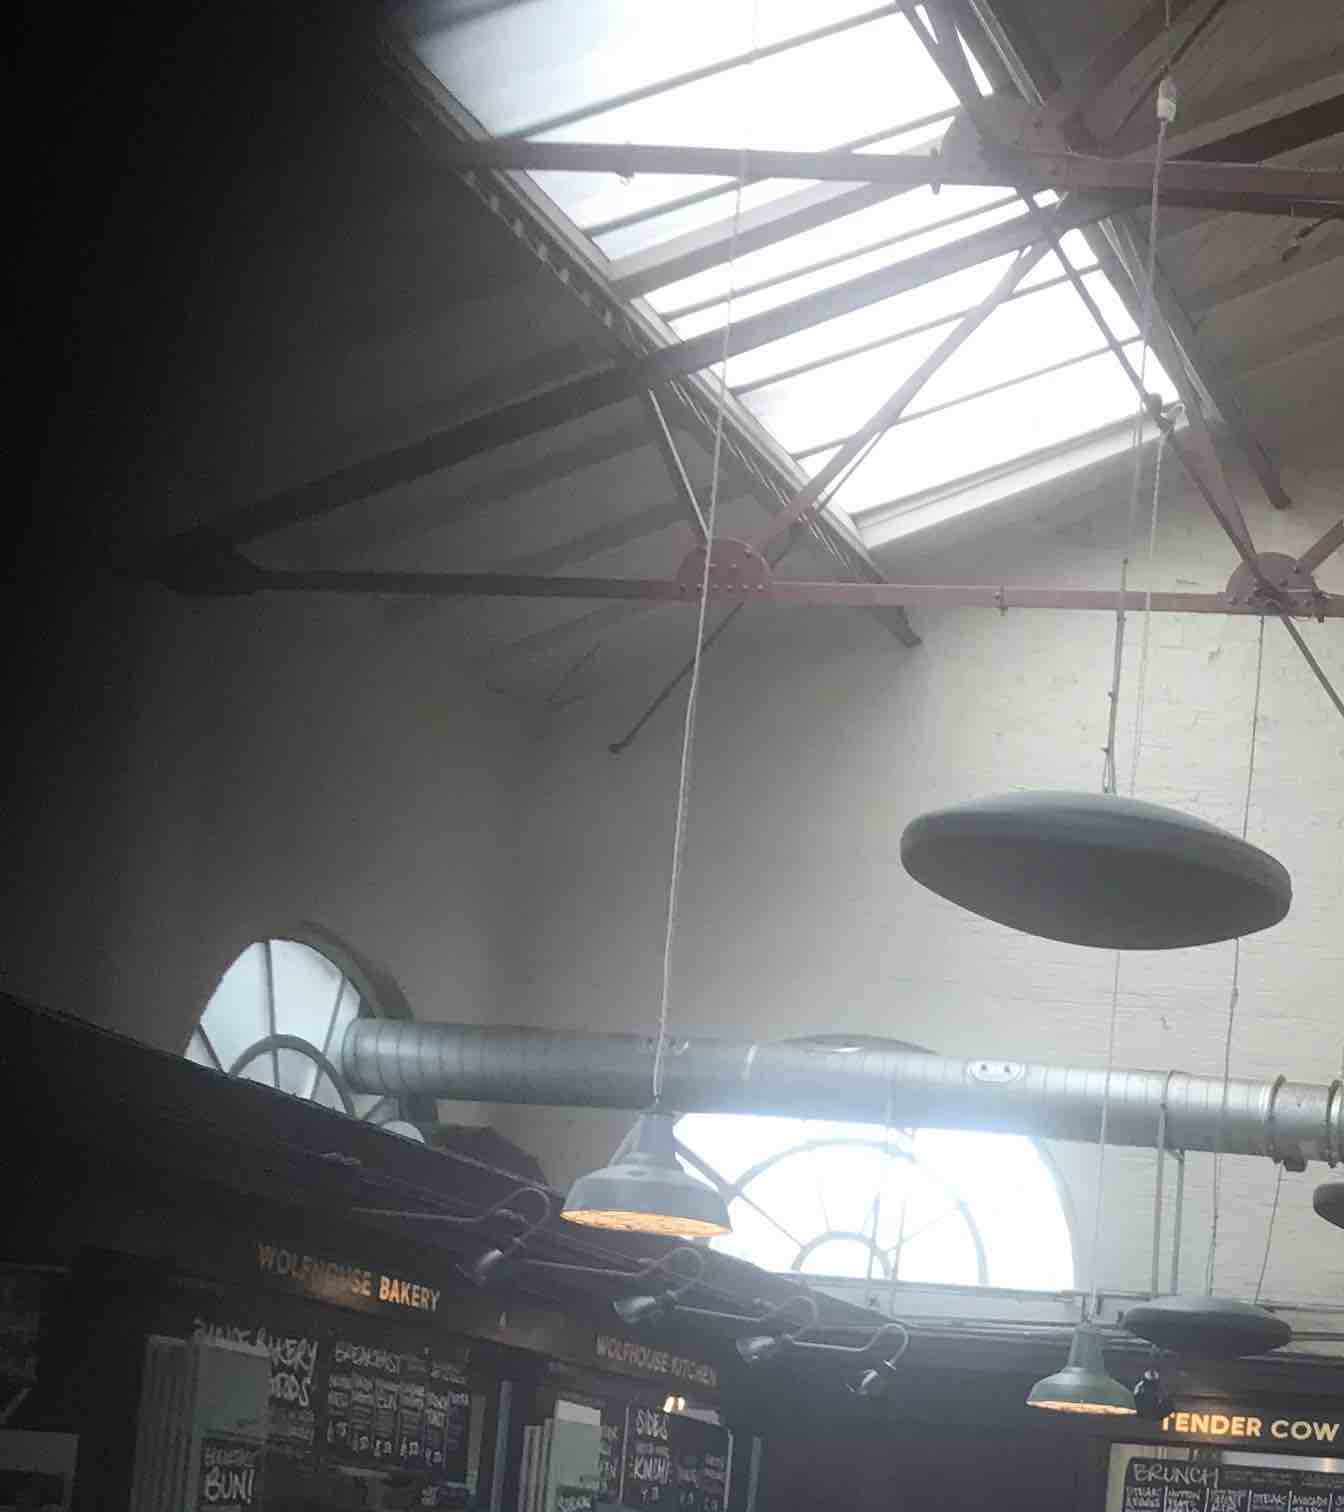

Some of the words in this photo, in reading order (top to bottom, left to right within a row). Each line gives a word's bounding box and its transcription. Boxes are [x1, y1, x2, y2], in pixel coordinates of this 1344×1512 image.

[378, 1275, 440, 1311] BAKERY
[1271, 1420, 1340, 1442] COW
[1133, 1463, 1219, 1487] BRUNCH
